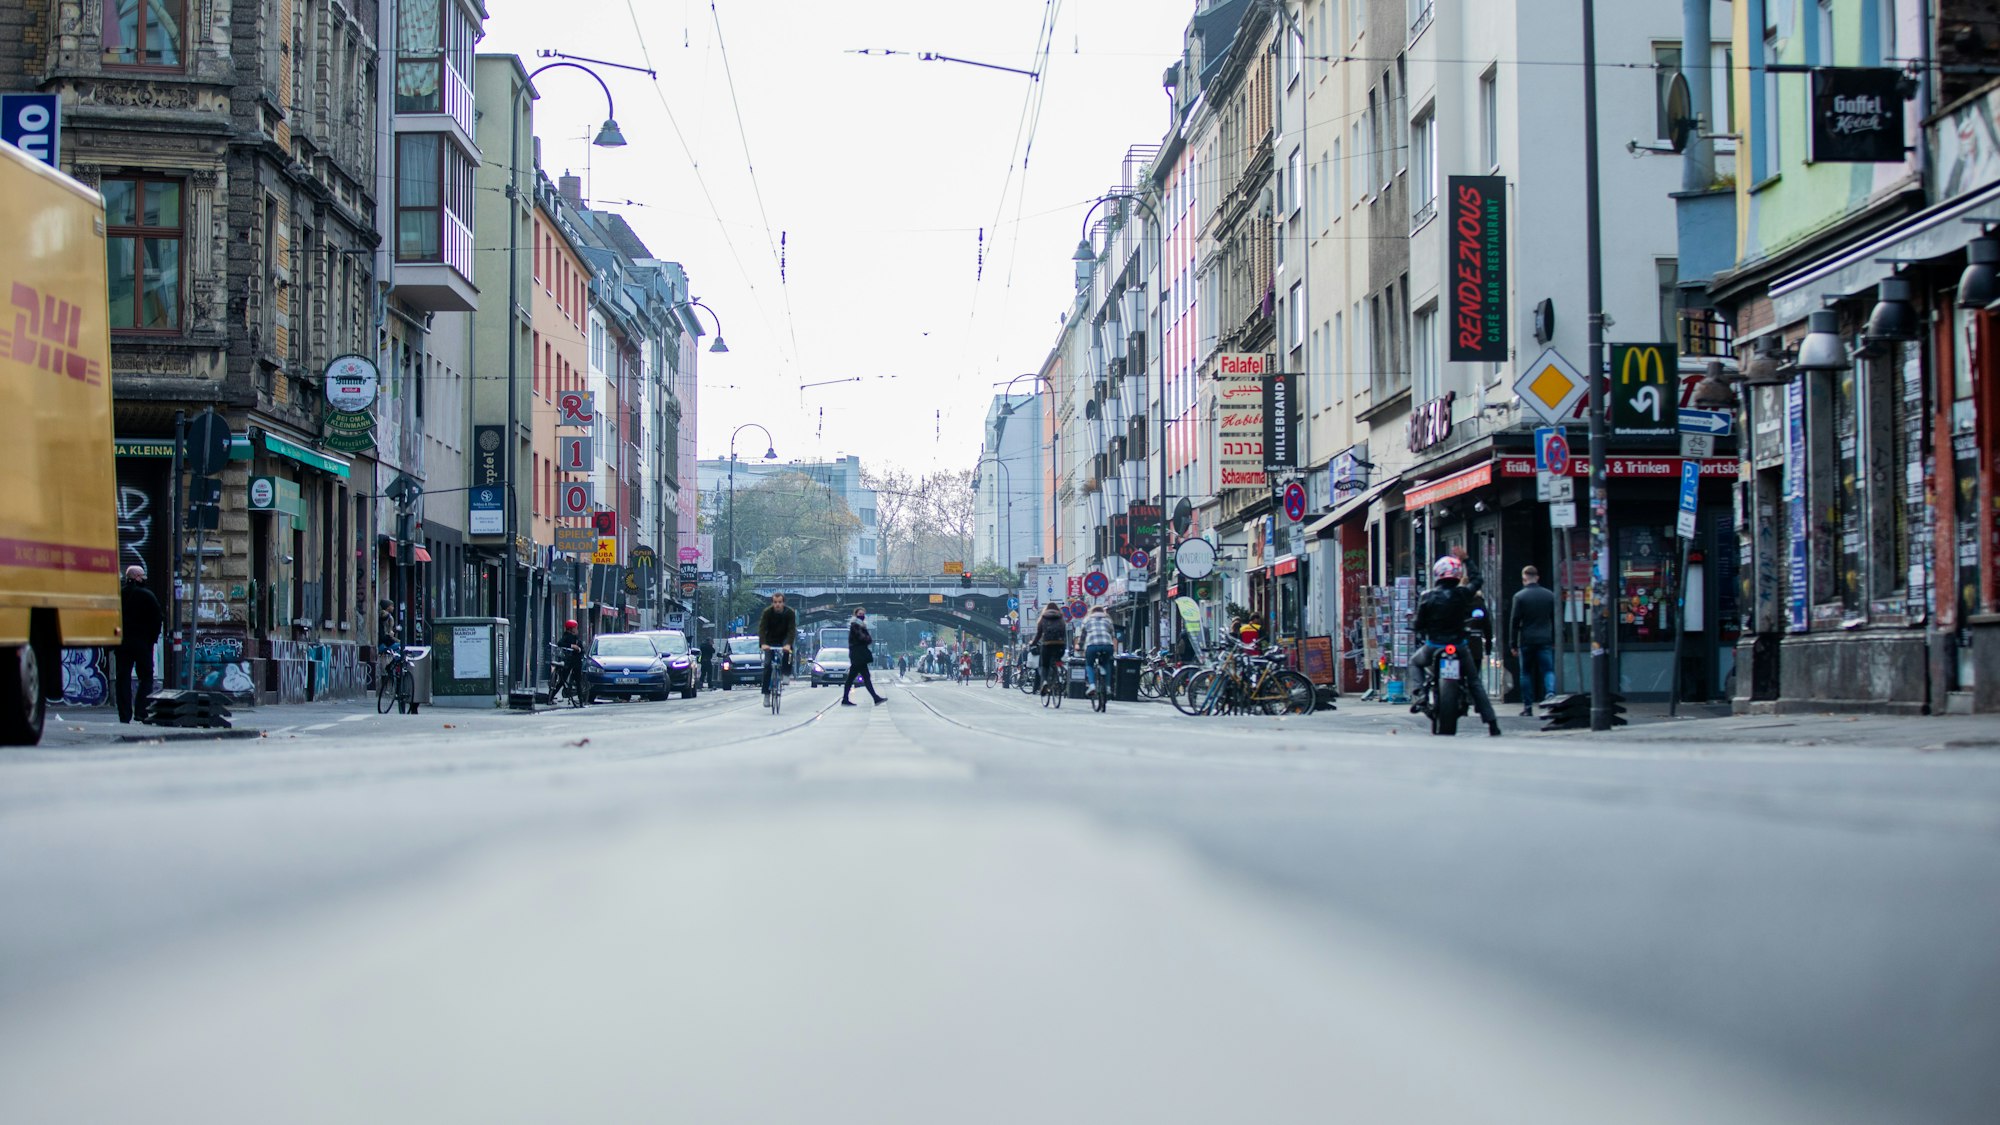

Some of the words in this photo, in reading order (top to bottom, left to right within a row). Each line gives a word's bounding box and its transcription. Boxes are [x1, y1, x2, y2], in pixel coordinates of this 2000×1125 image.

[1833, 95, 1883, 114] Gaffel
[1487, 199, 1500, 272] RESTAURANT
[1457, 185, 1482, 351] RENDEZVOUS
[1487, 282, 1500, 304] BAR
[11, 281, 88, 382] DHL
[1486, 313, 1500, 342] CAFÉ
[1221, 356, 1264, 374] Falafel
[330, 420, 371, 429] KLEINMANN
[349, 414, 366, 422] OMA
[1275, 376, 1286, 461] HILLEBRANDS
[1505, 460, 1531, 474] früh
[1575, 460, 1610, 474] Esn
[1613, 461, 1623, 474] &
[1625, 461, 1670, 474] Trinken
[1221, 468, 1266, 485] Schawarma
[558, 530, 587, 538] SPIEL
[558, 541, 593, 550] SALON
[680, 566, 698, 574] GYROS
